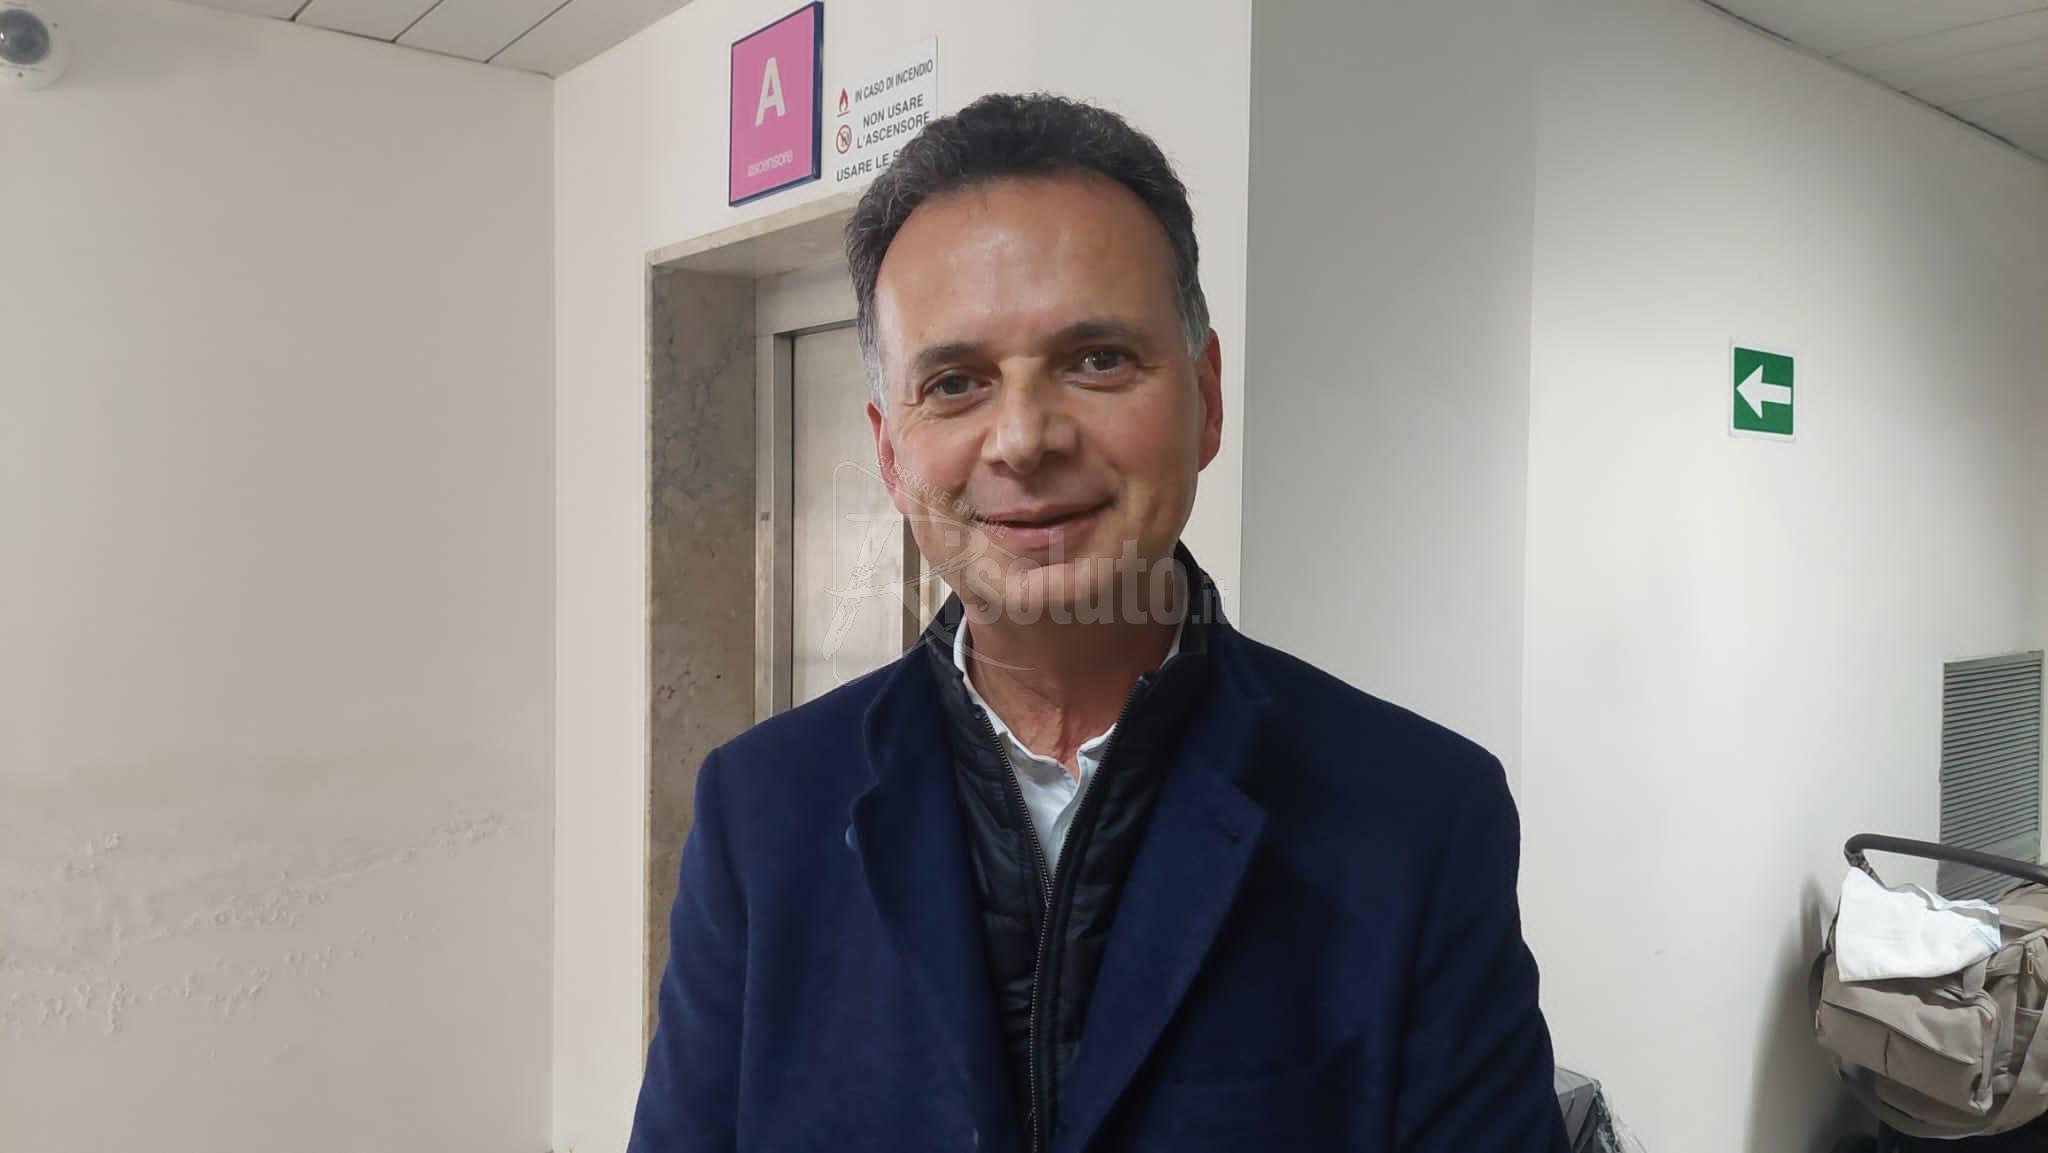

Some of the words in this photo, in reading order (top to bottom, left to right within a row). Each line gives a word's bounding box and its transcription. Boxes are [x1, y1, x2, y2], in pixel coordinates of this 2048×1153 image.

[755, 56, 786, 127] A
[855, 90, 863, 104] IN
[863, 79, 885, 100] CASO
[886, 76, 894, 92] DI
[895, 58, 934, 87] INCENDIO
[856, 110, 930, 149] L'ASCENSORE
[863, 109, 885, 128] NON
[887, 93, 924, 119] USARE
[836, 158, 873, 183] USARE
[875, 152, 889, 169] LE
